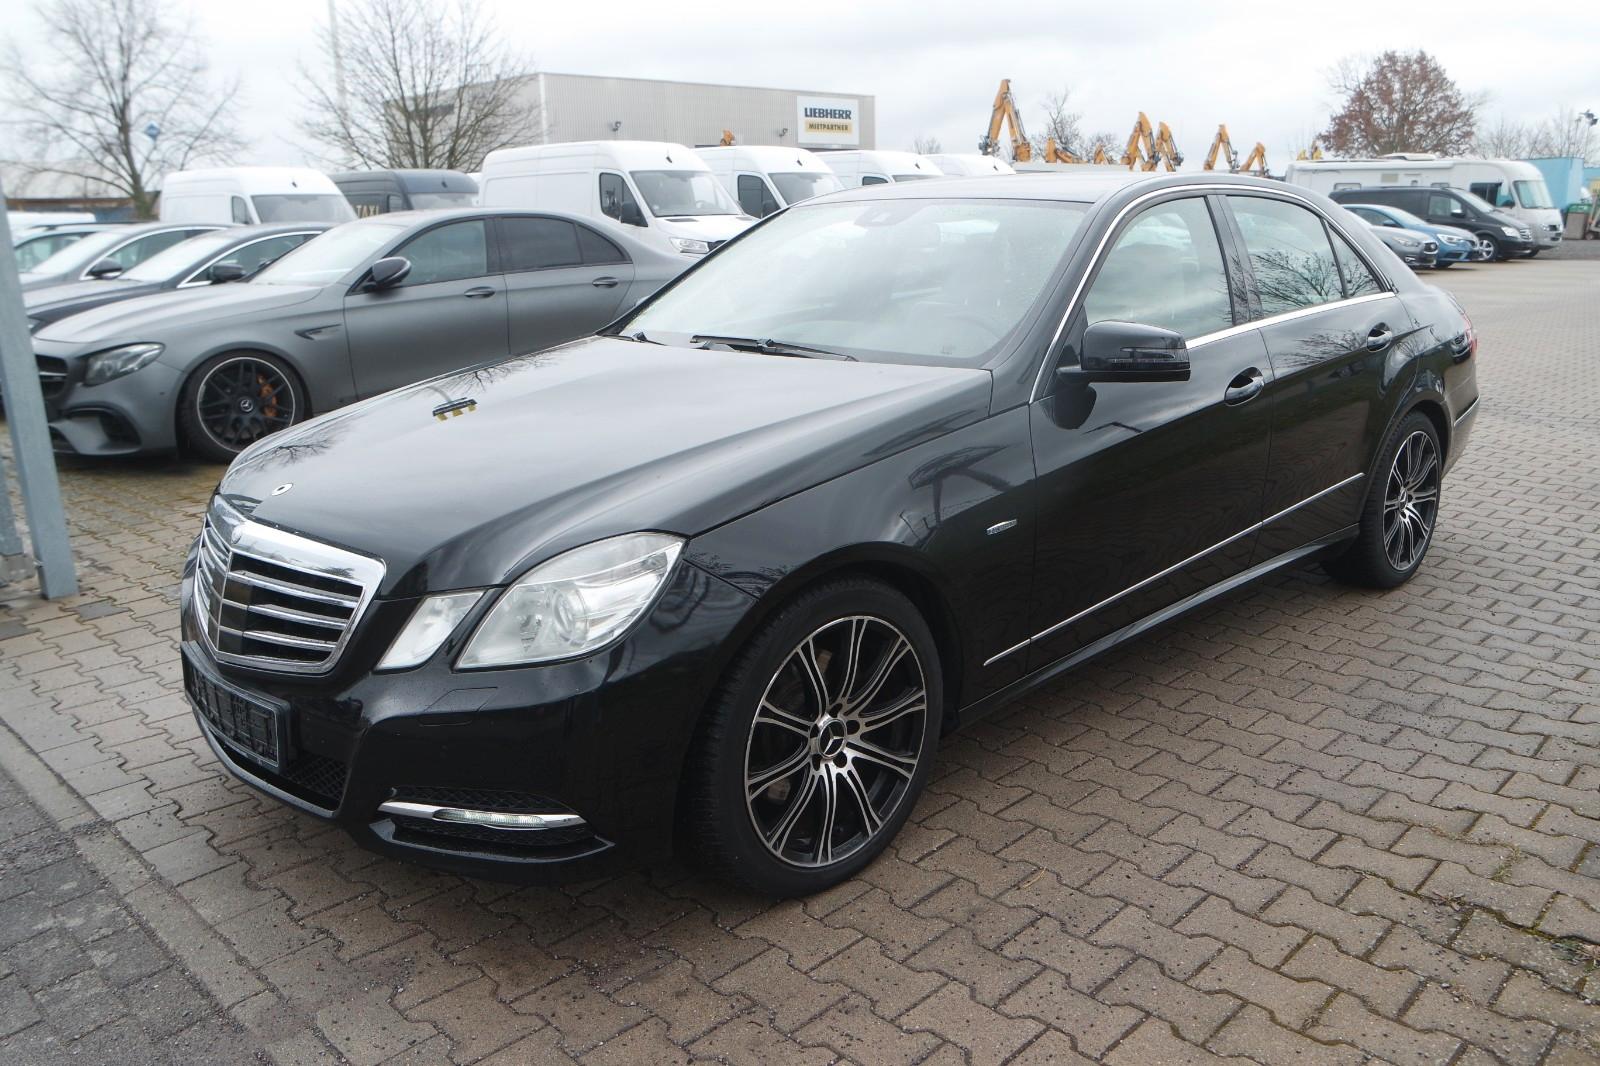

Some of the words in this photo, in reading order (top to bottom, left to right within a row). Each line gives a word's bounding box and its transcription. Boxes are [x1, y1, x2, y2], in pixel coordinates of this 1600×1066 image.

[804, 107, 852, 120] LIEBHERR
[808, 123, 849, 131] MIETPARTNER
[356, 205, 380, 218] TAXI
